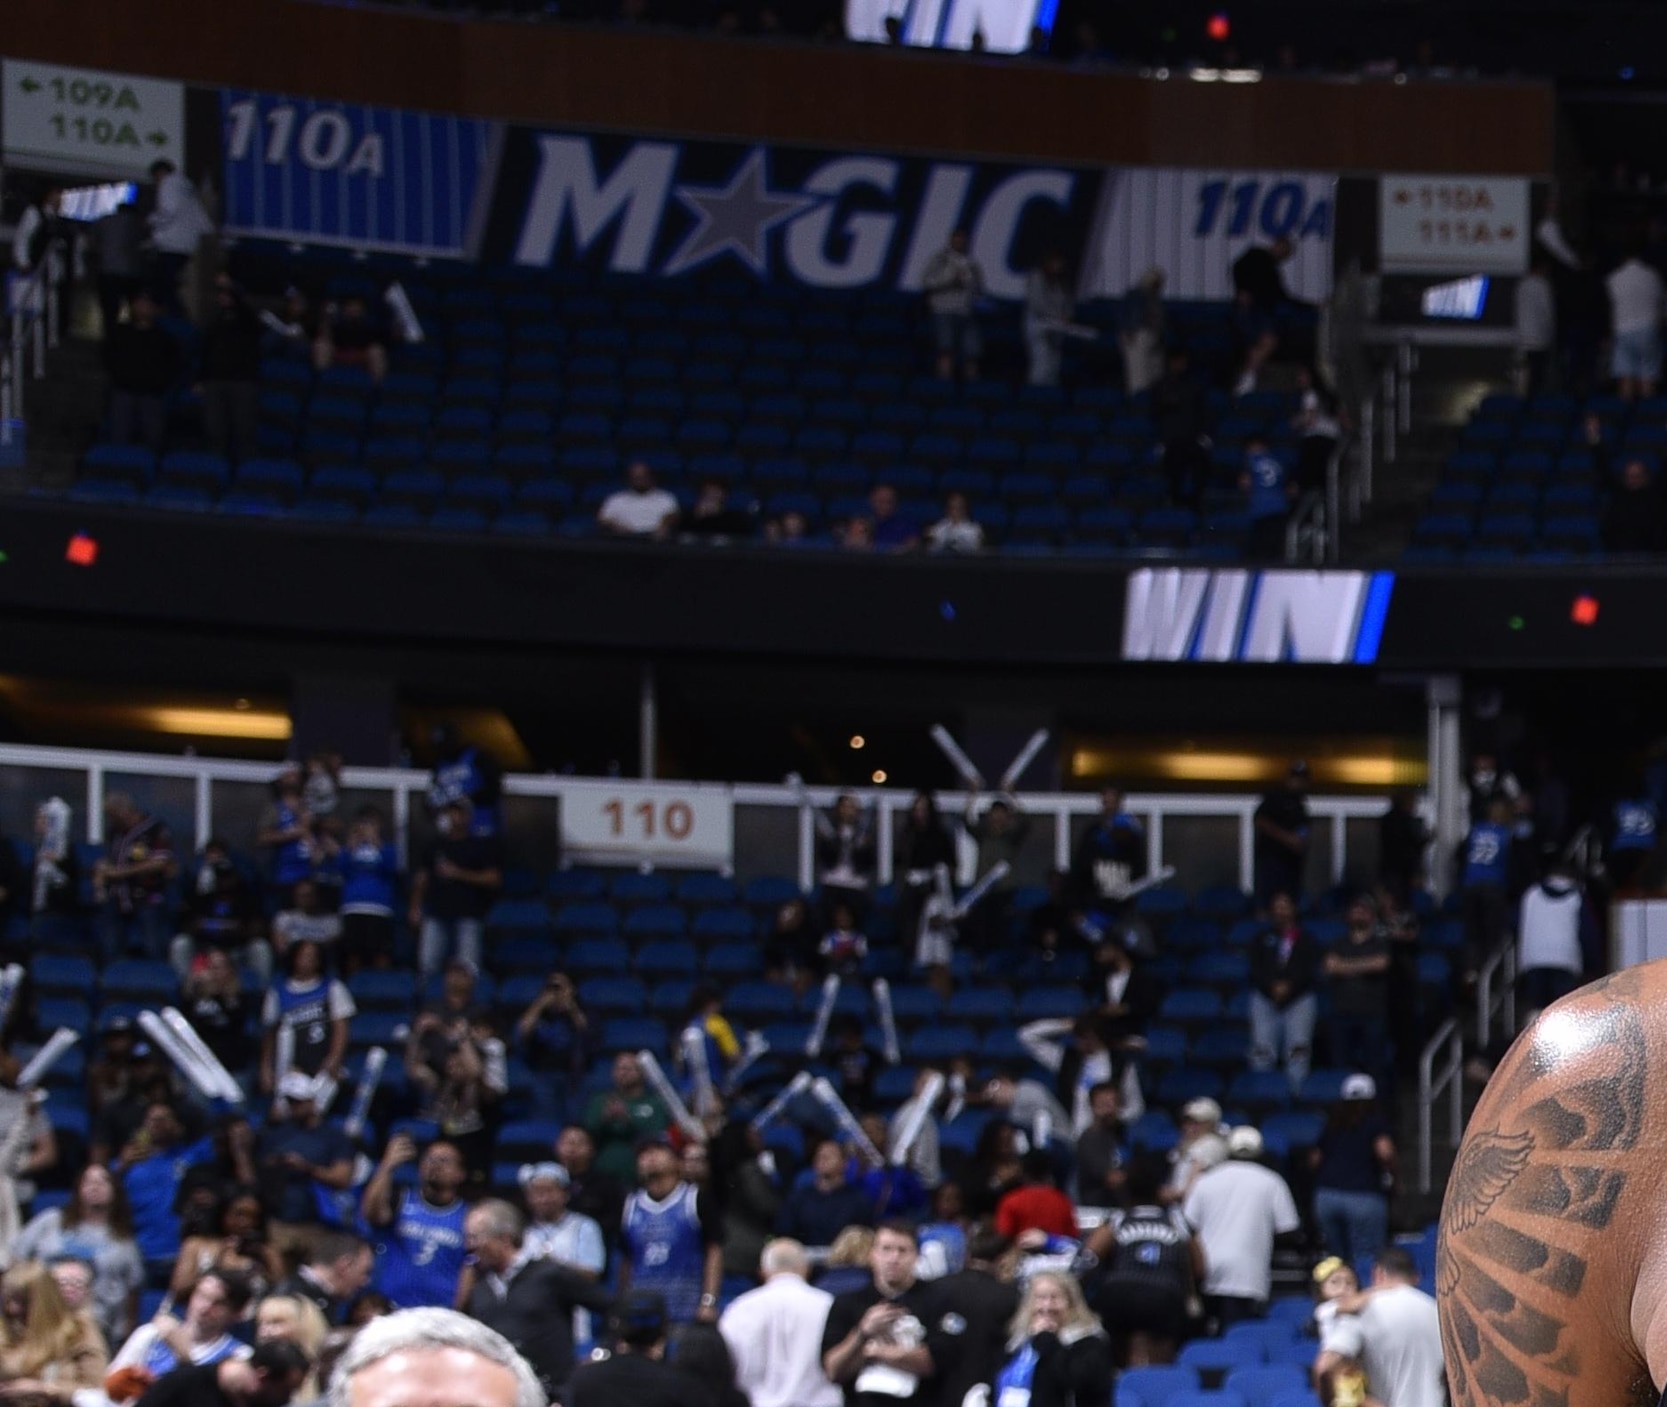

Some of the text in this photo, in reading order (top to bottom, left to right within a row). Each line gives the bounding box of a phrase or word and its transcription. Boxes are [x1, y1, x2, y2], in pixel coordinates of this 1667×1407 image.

[51, 76, 140, 110] 109A
[51, 113, 140, 146] 110A
[228, 99, 385, 178] 110A
[1194, 180, 1331, 240] 110A
[601, 797, 695, 841] 110
